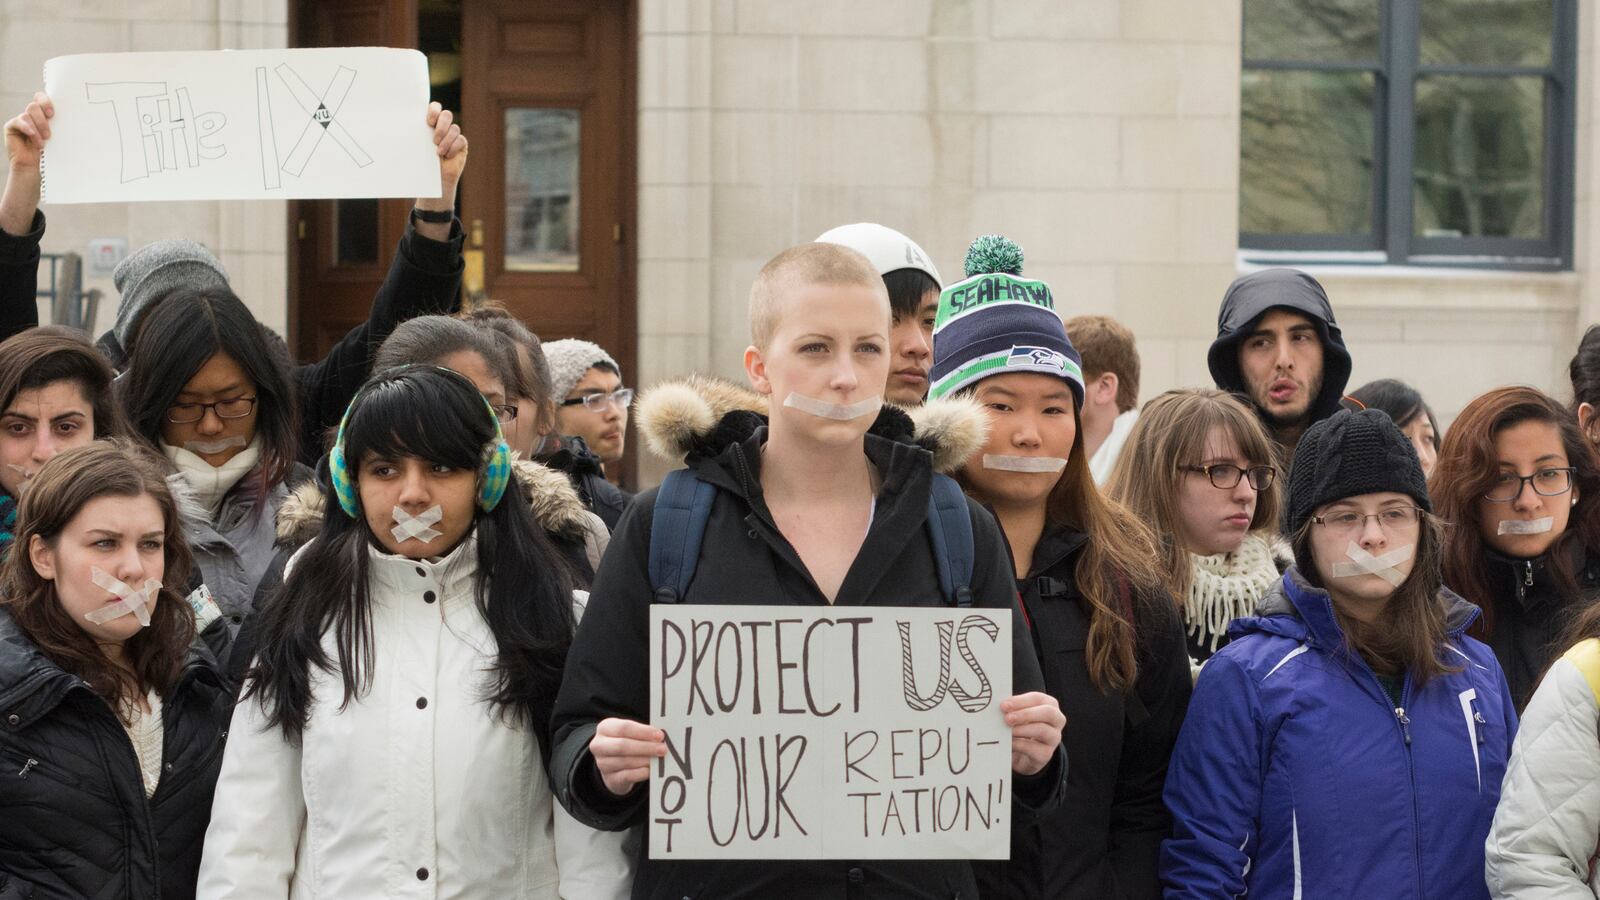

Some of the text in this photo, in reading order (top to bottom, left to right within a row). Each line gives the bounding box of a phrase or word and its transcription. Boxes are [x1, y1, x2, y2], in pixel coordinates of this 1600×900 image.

[85, 62, 375, 190] Title IX
[660, 615, 1000, 717] PROTECT US
[654, 726, 693, 853] NOT
[707, 728, 1000, 847] OUR REPU-
[847, 779, 1004, 838] TATION!
